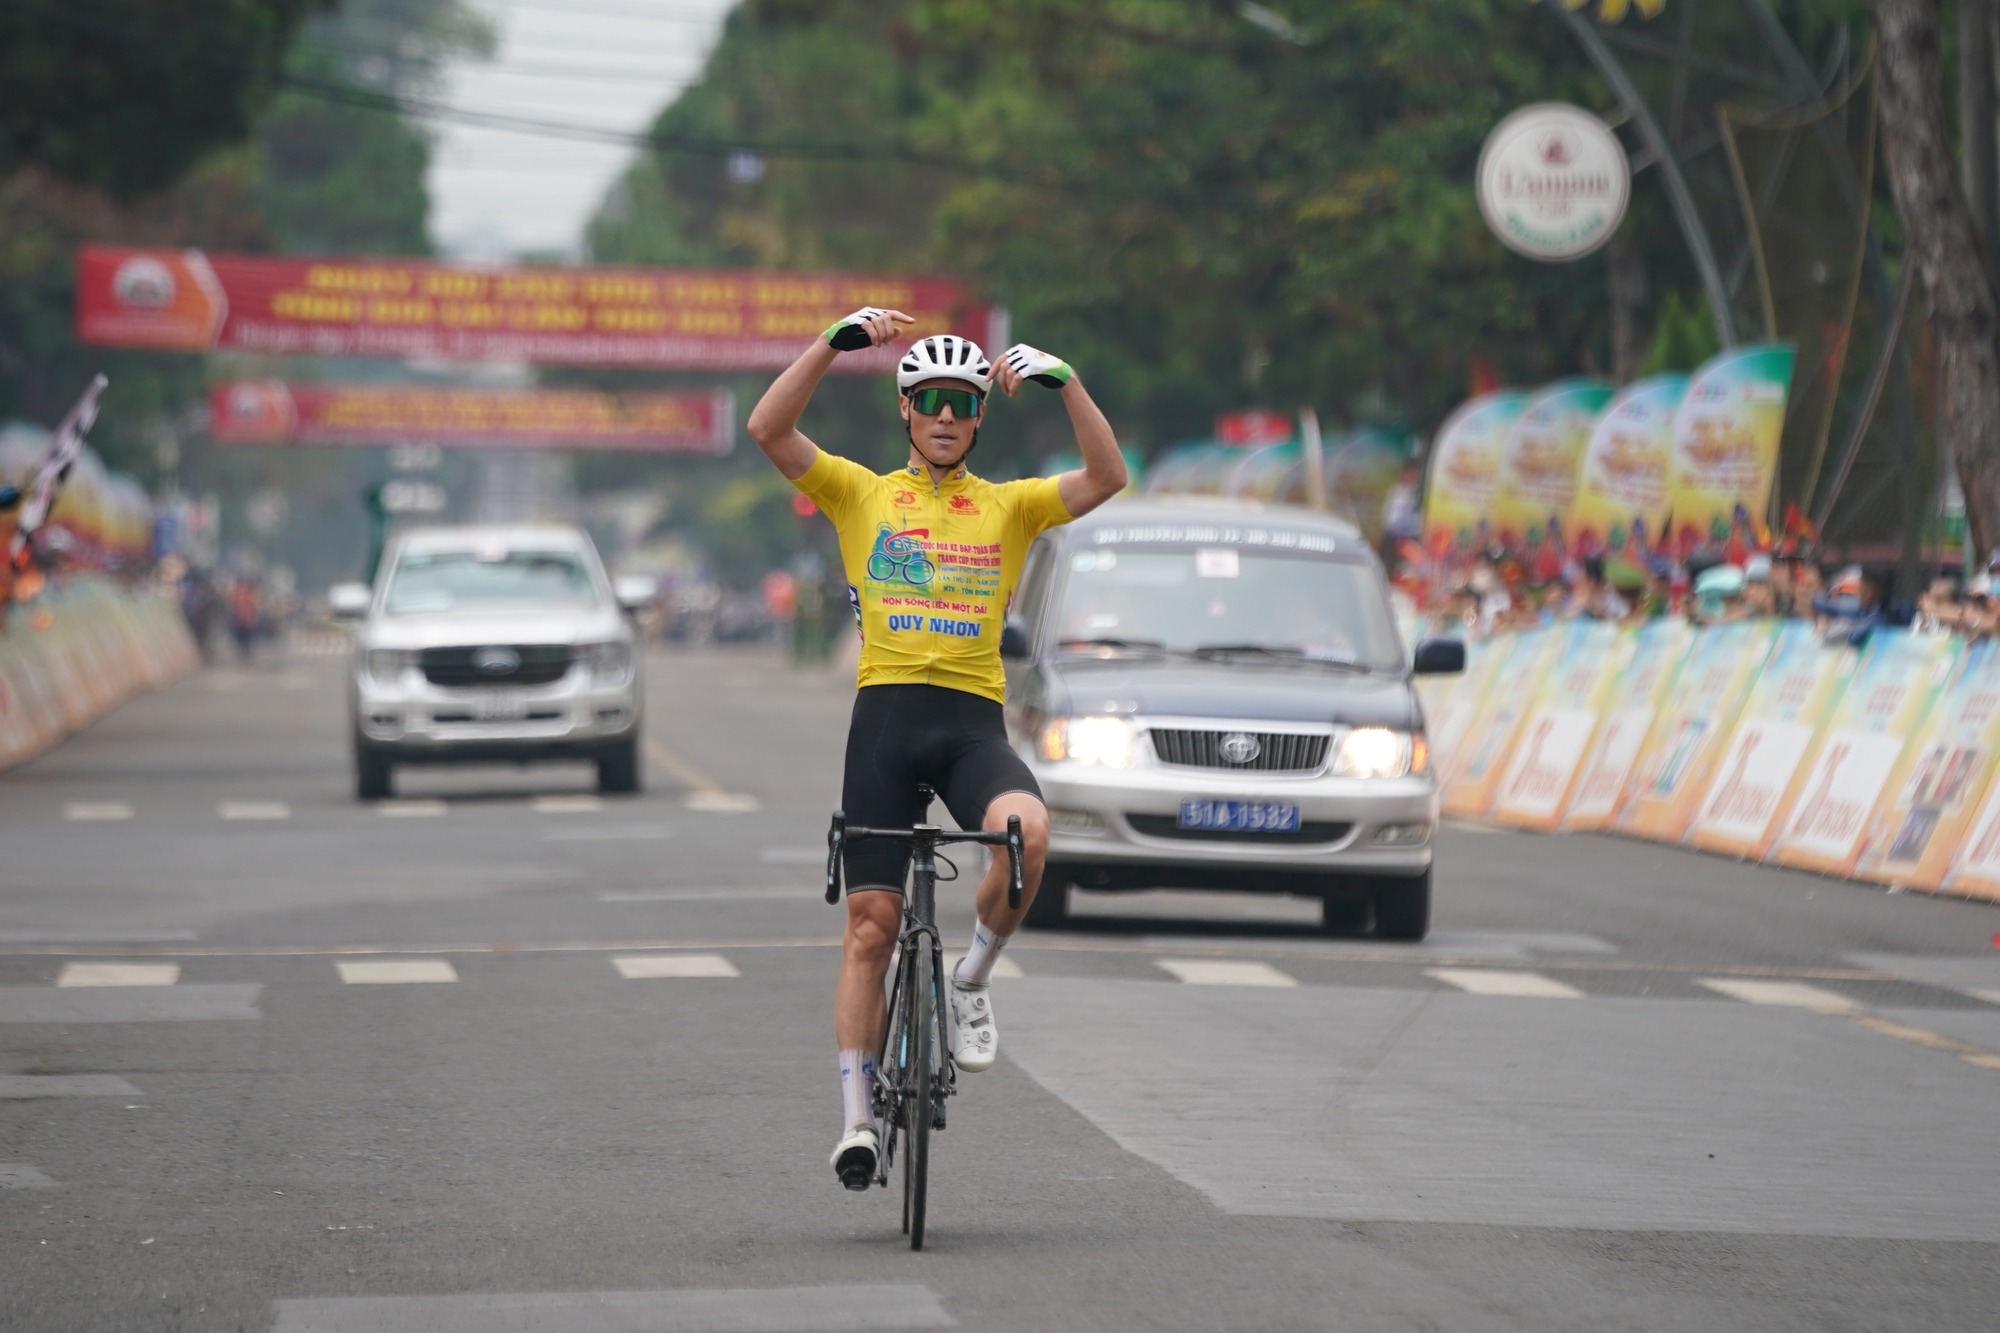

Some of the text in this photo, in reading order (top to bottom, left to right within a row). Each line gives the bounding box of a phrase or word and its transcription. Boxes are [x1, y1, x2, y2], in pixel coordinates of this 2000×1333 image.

[882, 596, 902, 606] NON
[904, 596, 931, 610] SÔNG
[951, 602, 971, 615] MỘT
[888, 614, 981, 637] QUY NHƠN
